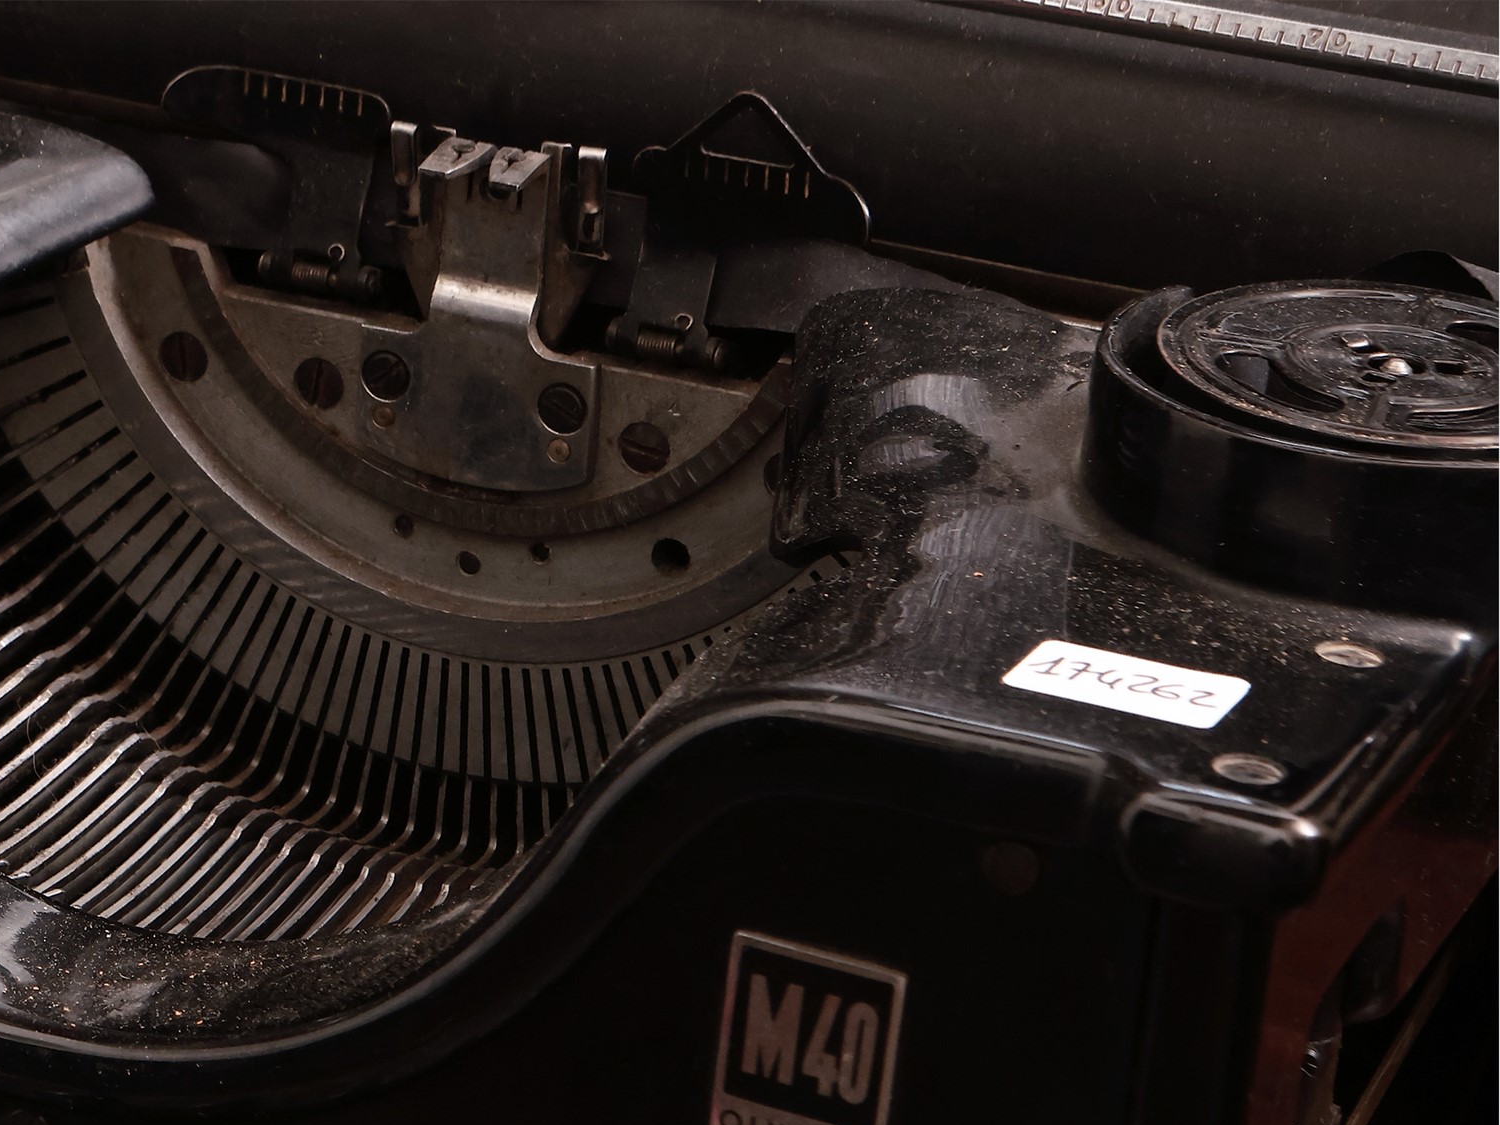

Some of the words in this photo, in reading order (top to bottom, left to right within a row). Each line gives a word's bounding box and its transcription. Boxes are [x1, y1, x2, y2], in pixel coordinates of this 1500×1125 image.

[1308, 27, 1348, 47] 70
[1028, 657, 1219, 708] 174262
[741, 973, 879, 1105] M40
